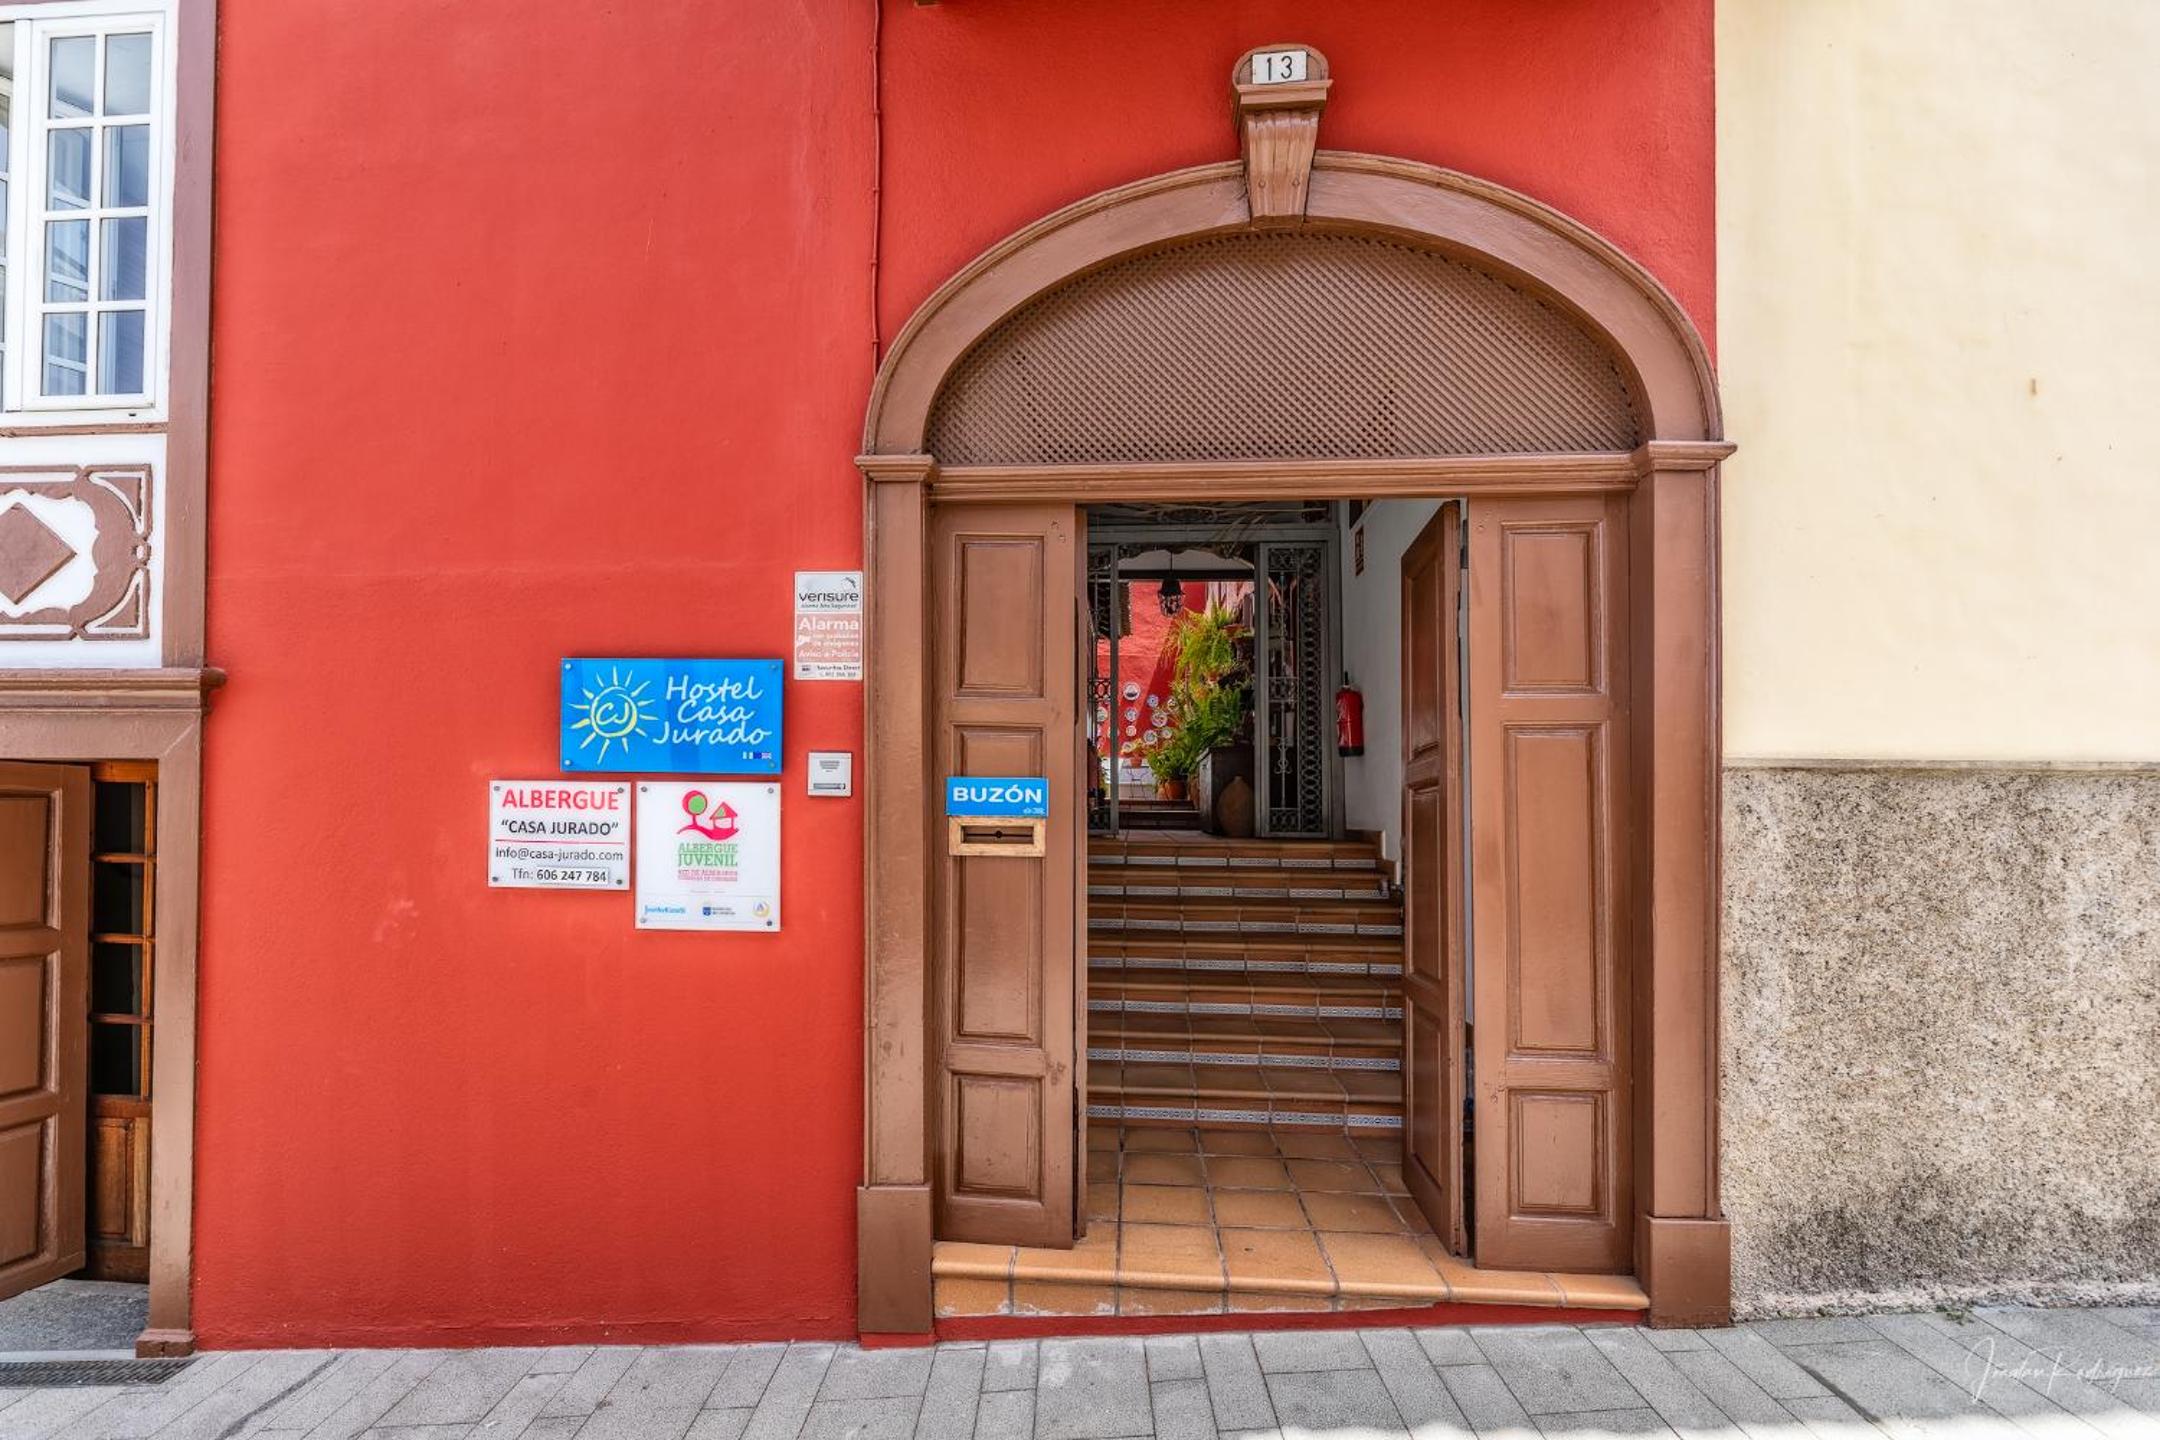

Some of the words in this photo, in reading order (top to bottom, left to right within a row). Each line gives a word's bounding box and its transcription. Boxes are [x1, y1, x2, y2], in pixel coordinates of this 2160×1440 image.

[1266, 55, 1293, 81] 13
[799, 592, 859, 602] verisure
[799, 617, 859, 632] Alarma
[665, 674, 764, 703] Hostel
[595, 702, 631, 725] CJ
[677, 700, 755, 726] Casa
[652, 720, 773, 746] Jurado
[502, 788, 619, 810] ALBERGUE
[952, 784, 1042, 804] BUZÓN
[678, 843, 738, 853] ALBERGUE
[678, 854, 738, 867] JUVENIL
[536, 869, 558, 881] 606
[561, 870, 582, 882] 247
[586, 871, 607, 883] 784
